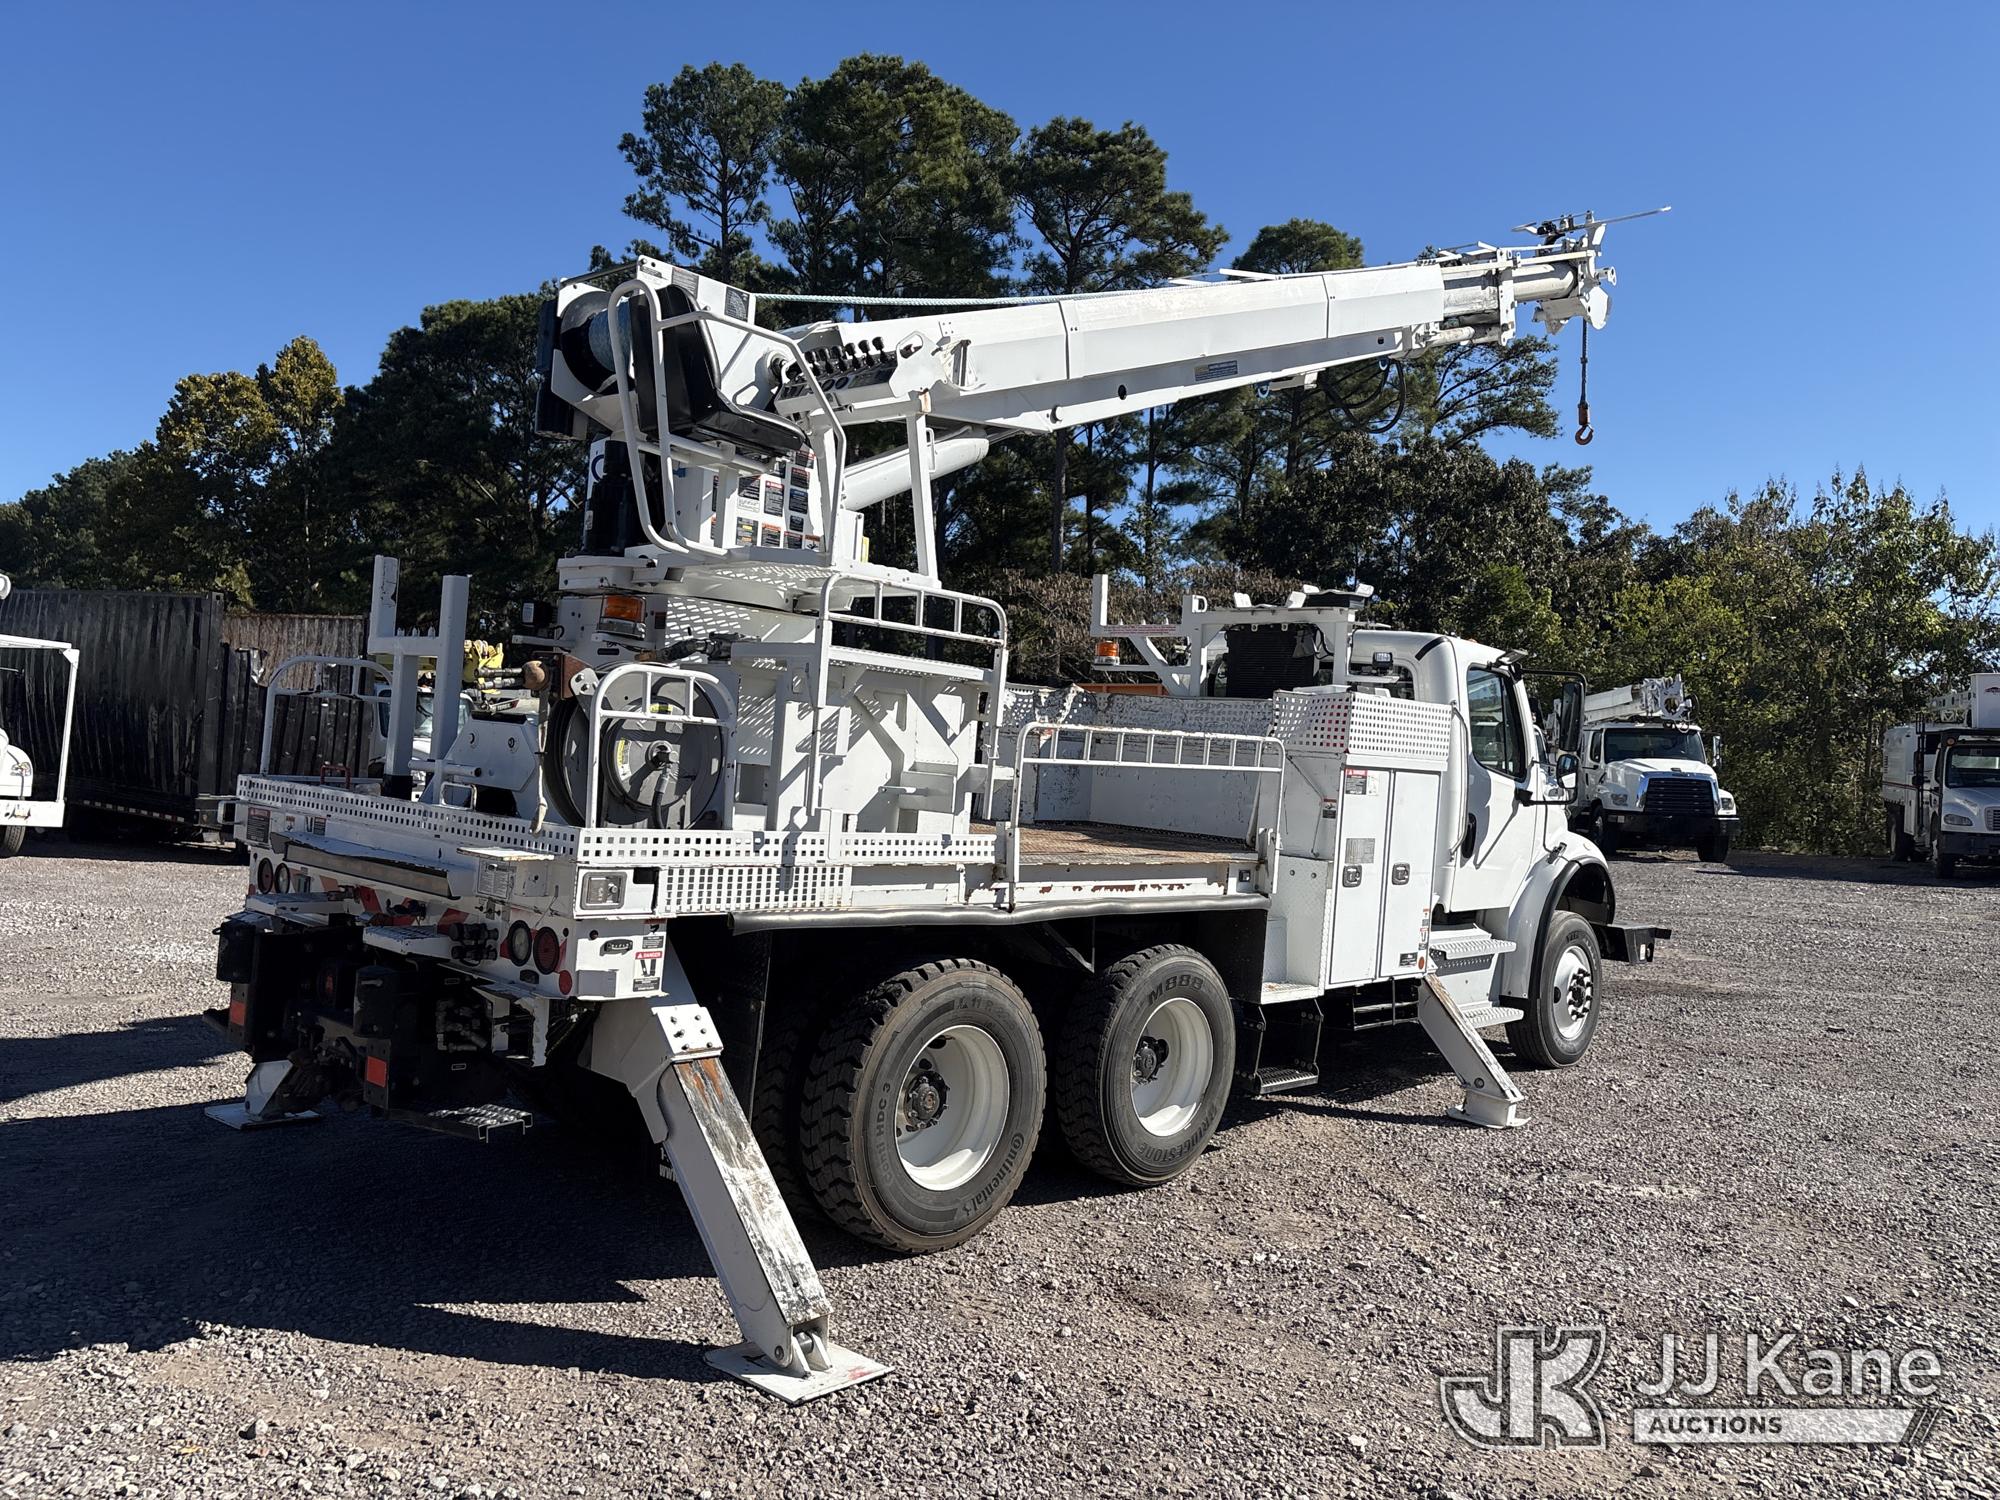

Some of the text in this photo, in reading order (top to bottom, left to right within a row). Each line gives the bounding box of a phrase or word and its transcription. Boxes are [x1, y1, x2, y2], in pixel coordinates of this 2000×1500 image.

[1148, 974, 1204, 1006] M888
[876, 1098, 888, 1137] HDC
[882, 1082, 891, 1094] 3
